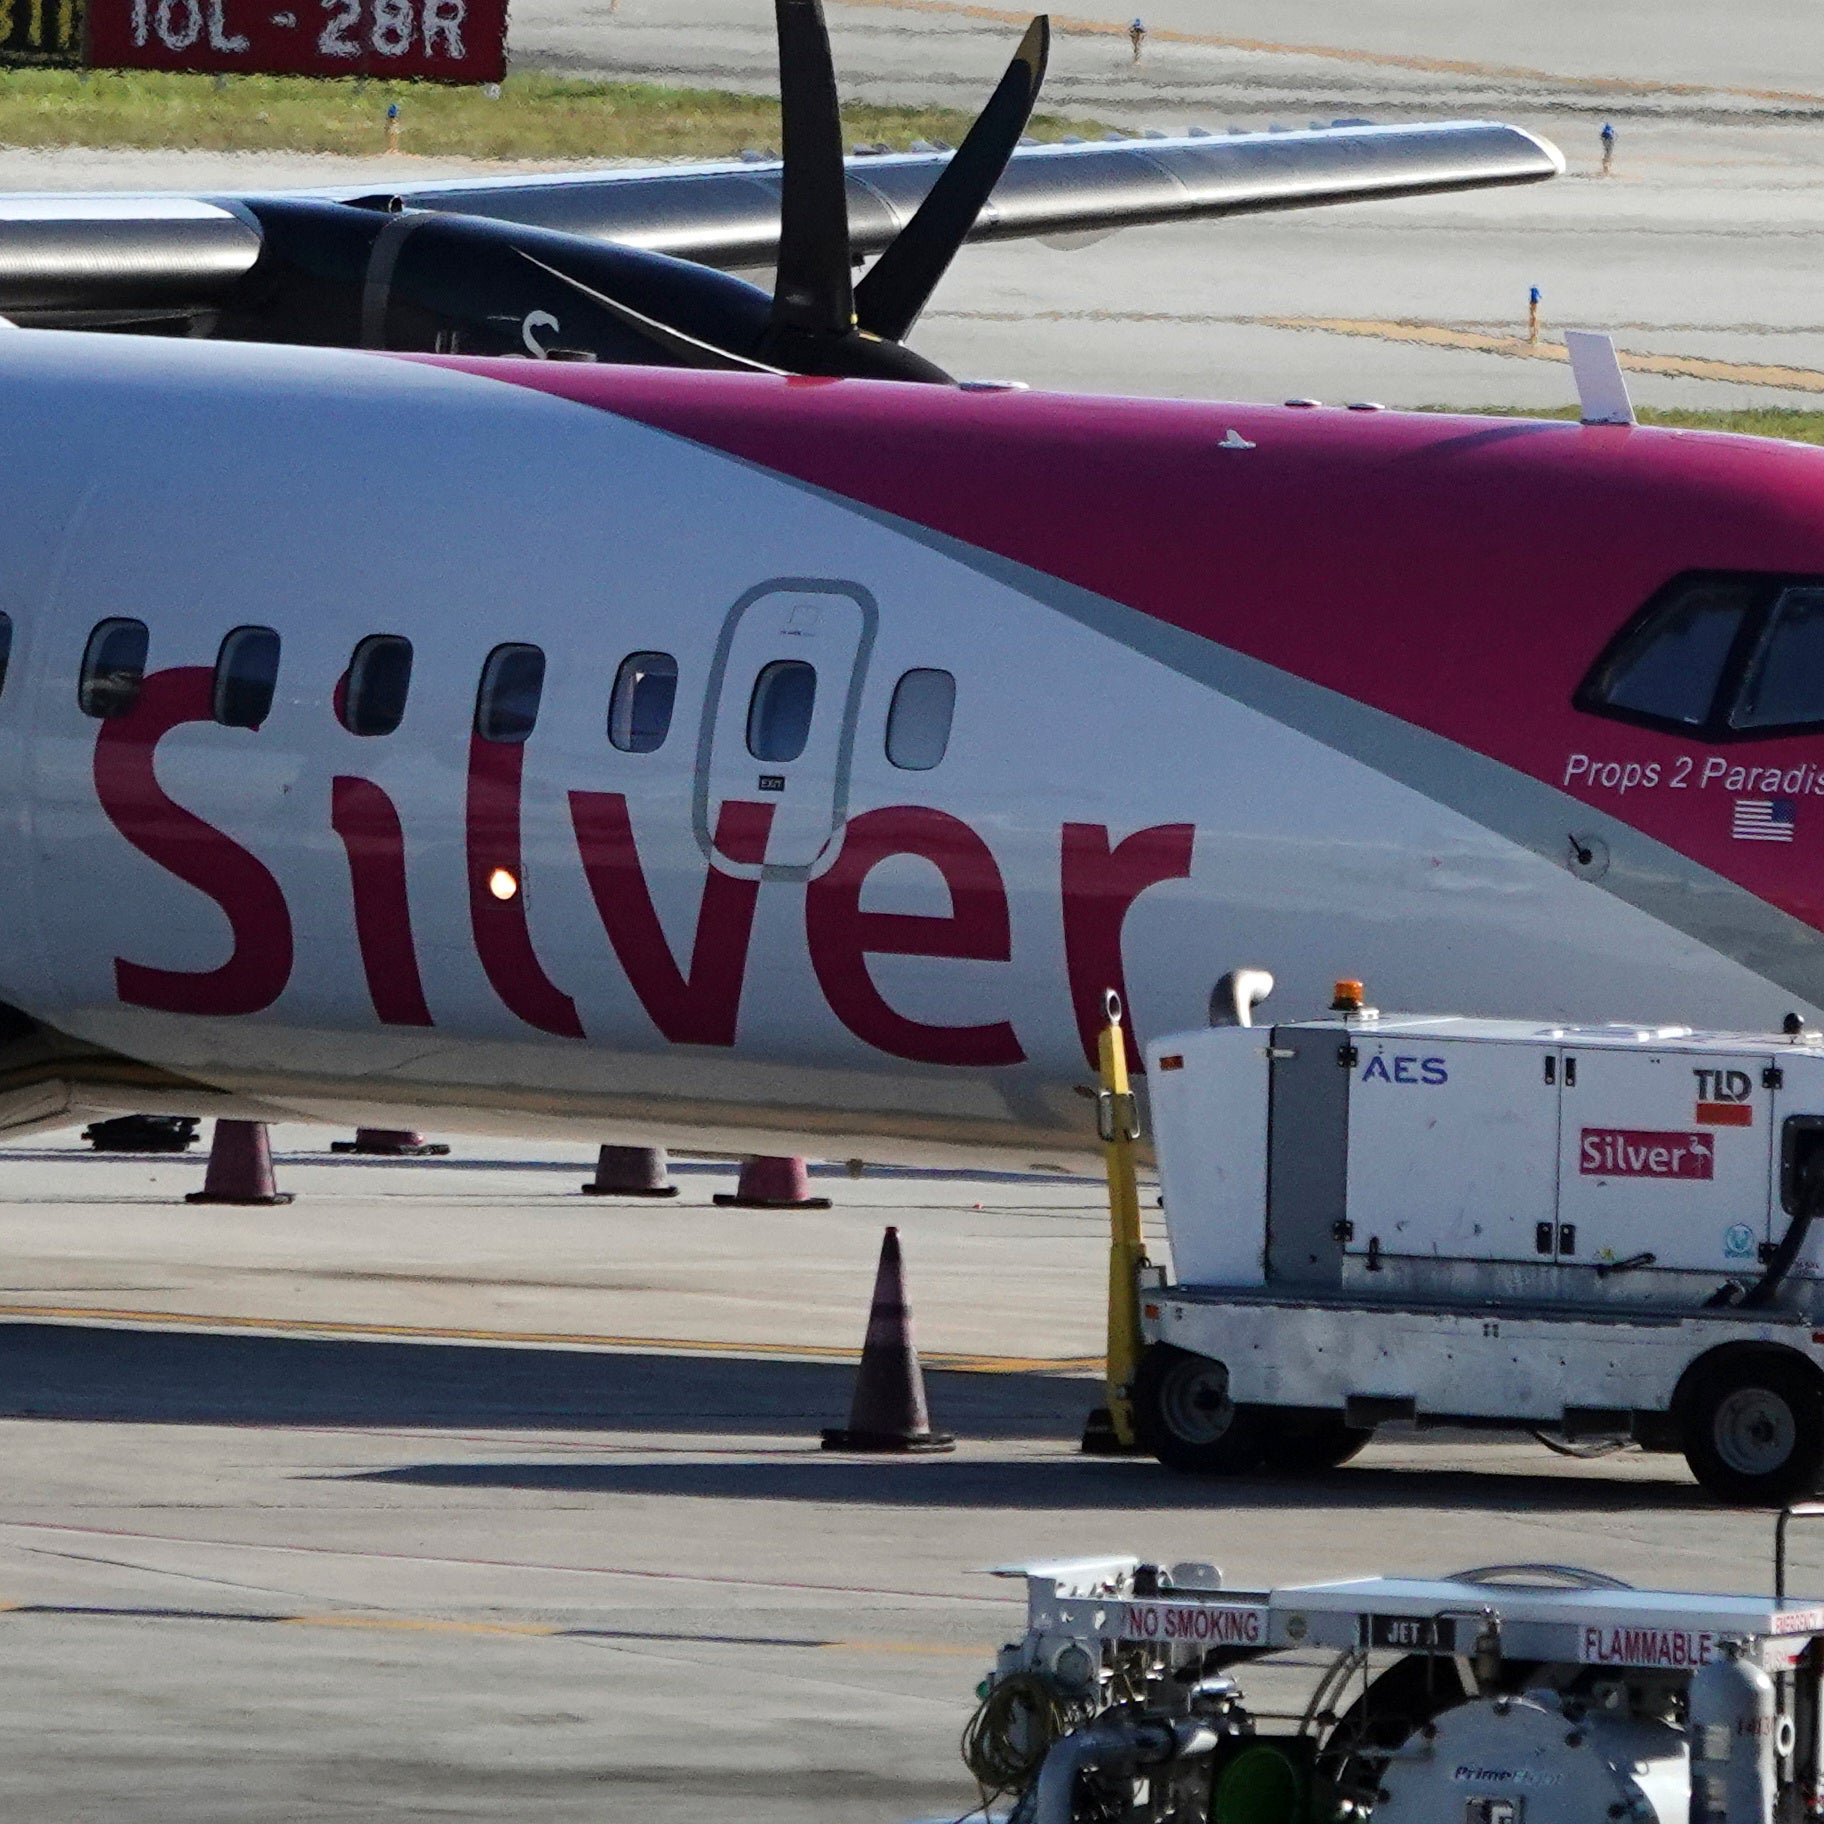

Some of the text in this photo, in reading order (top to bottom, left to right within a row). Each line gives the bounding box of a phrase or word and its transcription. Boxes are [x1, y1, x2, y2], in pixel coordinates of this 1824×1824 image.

[1563, 753, 1662, 795] Props
[1669, 755, 1694, 789] 2
[92, 664, 1197, 1076] Silver
[1361, 1054, 1450, 1086] AES
[1692, 1067, 1753, 1103] TLD
[1582, 1134, 1688, 1174] Silver
[1130, 1607, 1260, 1642] NO SMOKING
[1387, 1622, 1421, 1645] JET
[1584, 1625, 1714, 1667] FLAMMABLE
